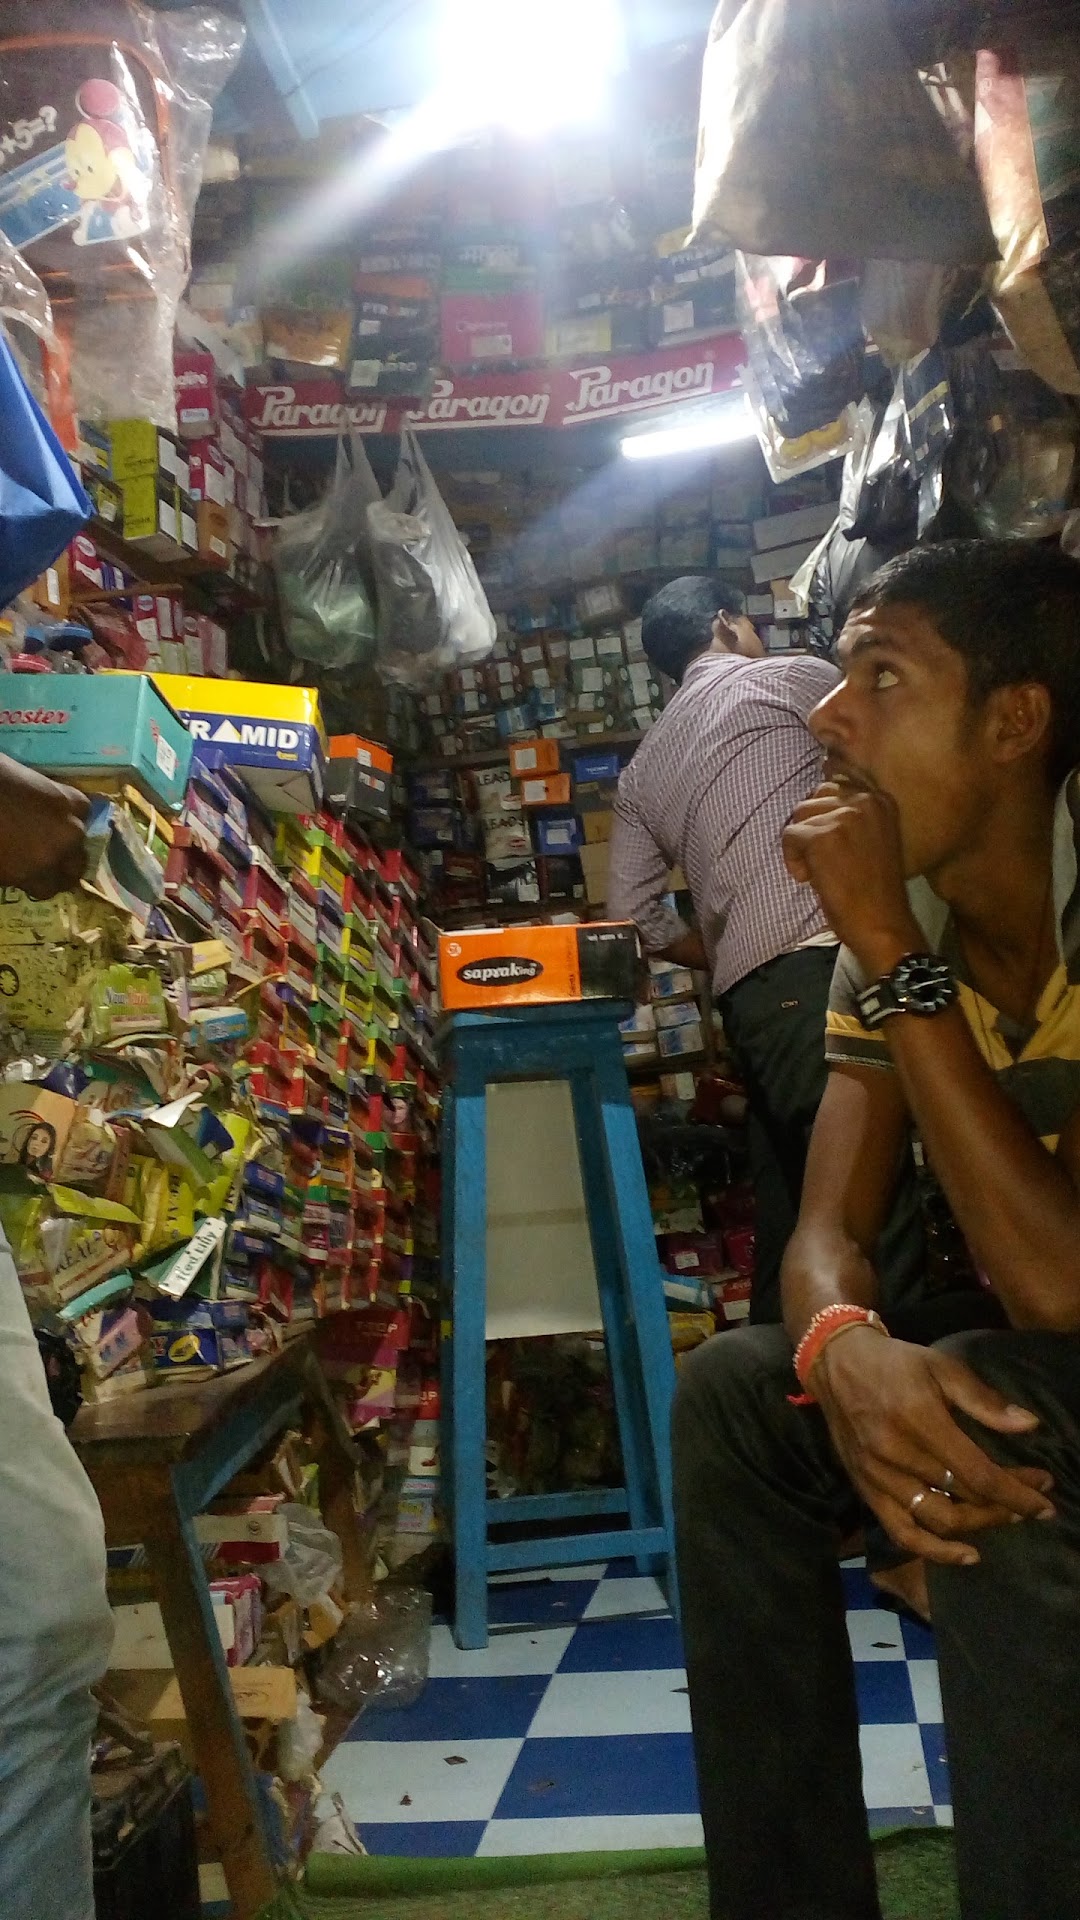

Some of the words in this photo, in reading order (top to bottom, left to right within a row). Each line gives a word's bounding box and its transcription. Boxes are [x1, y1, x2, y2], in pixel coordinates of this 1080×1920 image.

[250, 386, 388, 432] Paragon
[402, 380, 550, 424] Paragon
[563, 364, 715, 420] Paragon
[181, 718, 300, 749] RAMID
